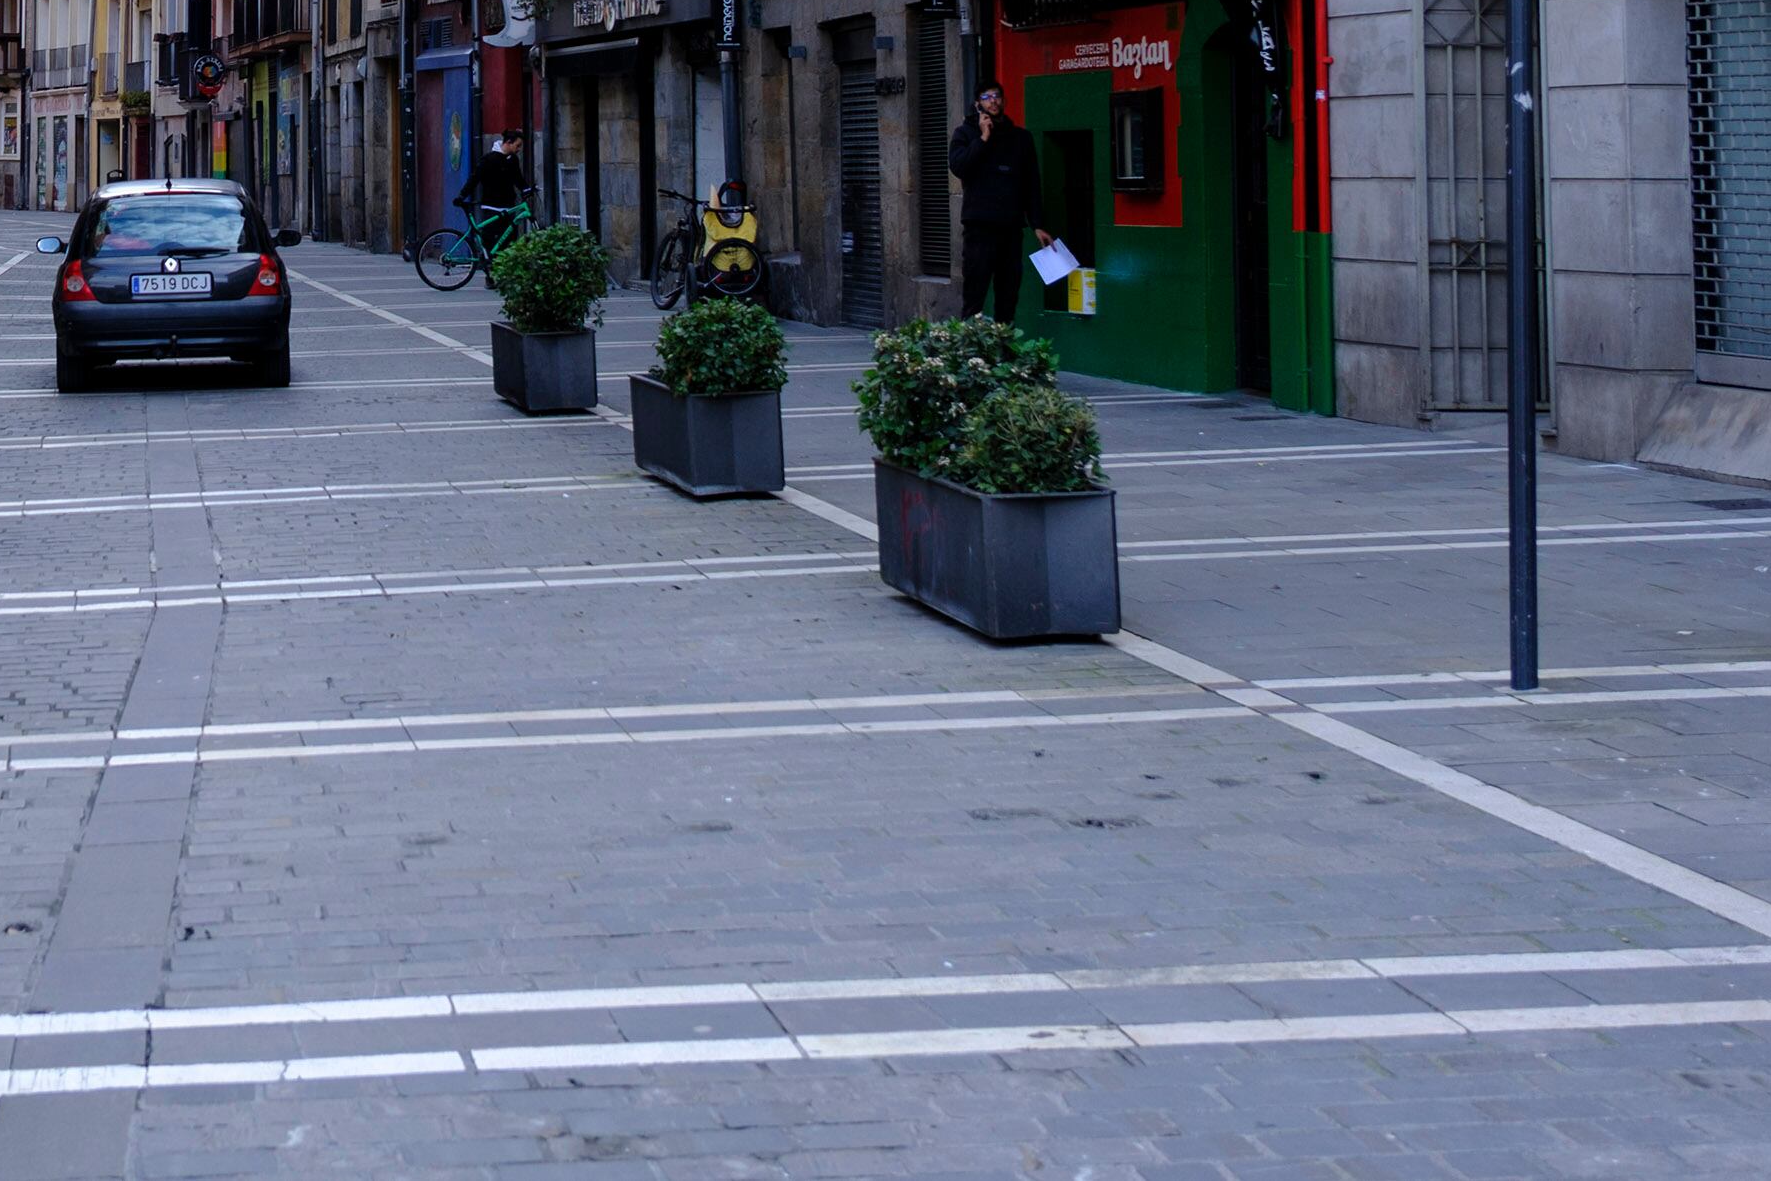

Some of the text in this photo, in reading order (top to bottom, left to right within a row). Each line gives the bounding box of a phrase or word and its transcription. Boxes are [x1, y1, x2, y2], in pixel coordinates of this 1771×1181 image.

[1075, 42, 1110, 55] CERVECERIA
[1059, 56, 1110, 70] GARAGARDOTEGIA
[1112, 35, 1172, 79] Baztan
[142, 276, 207, 291] 7519 DCJ
